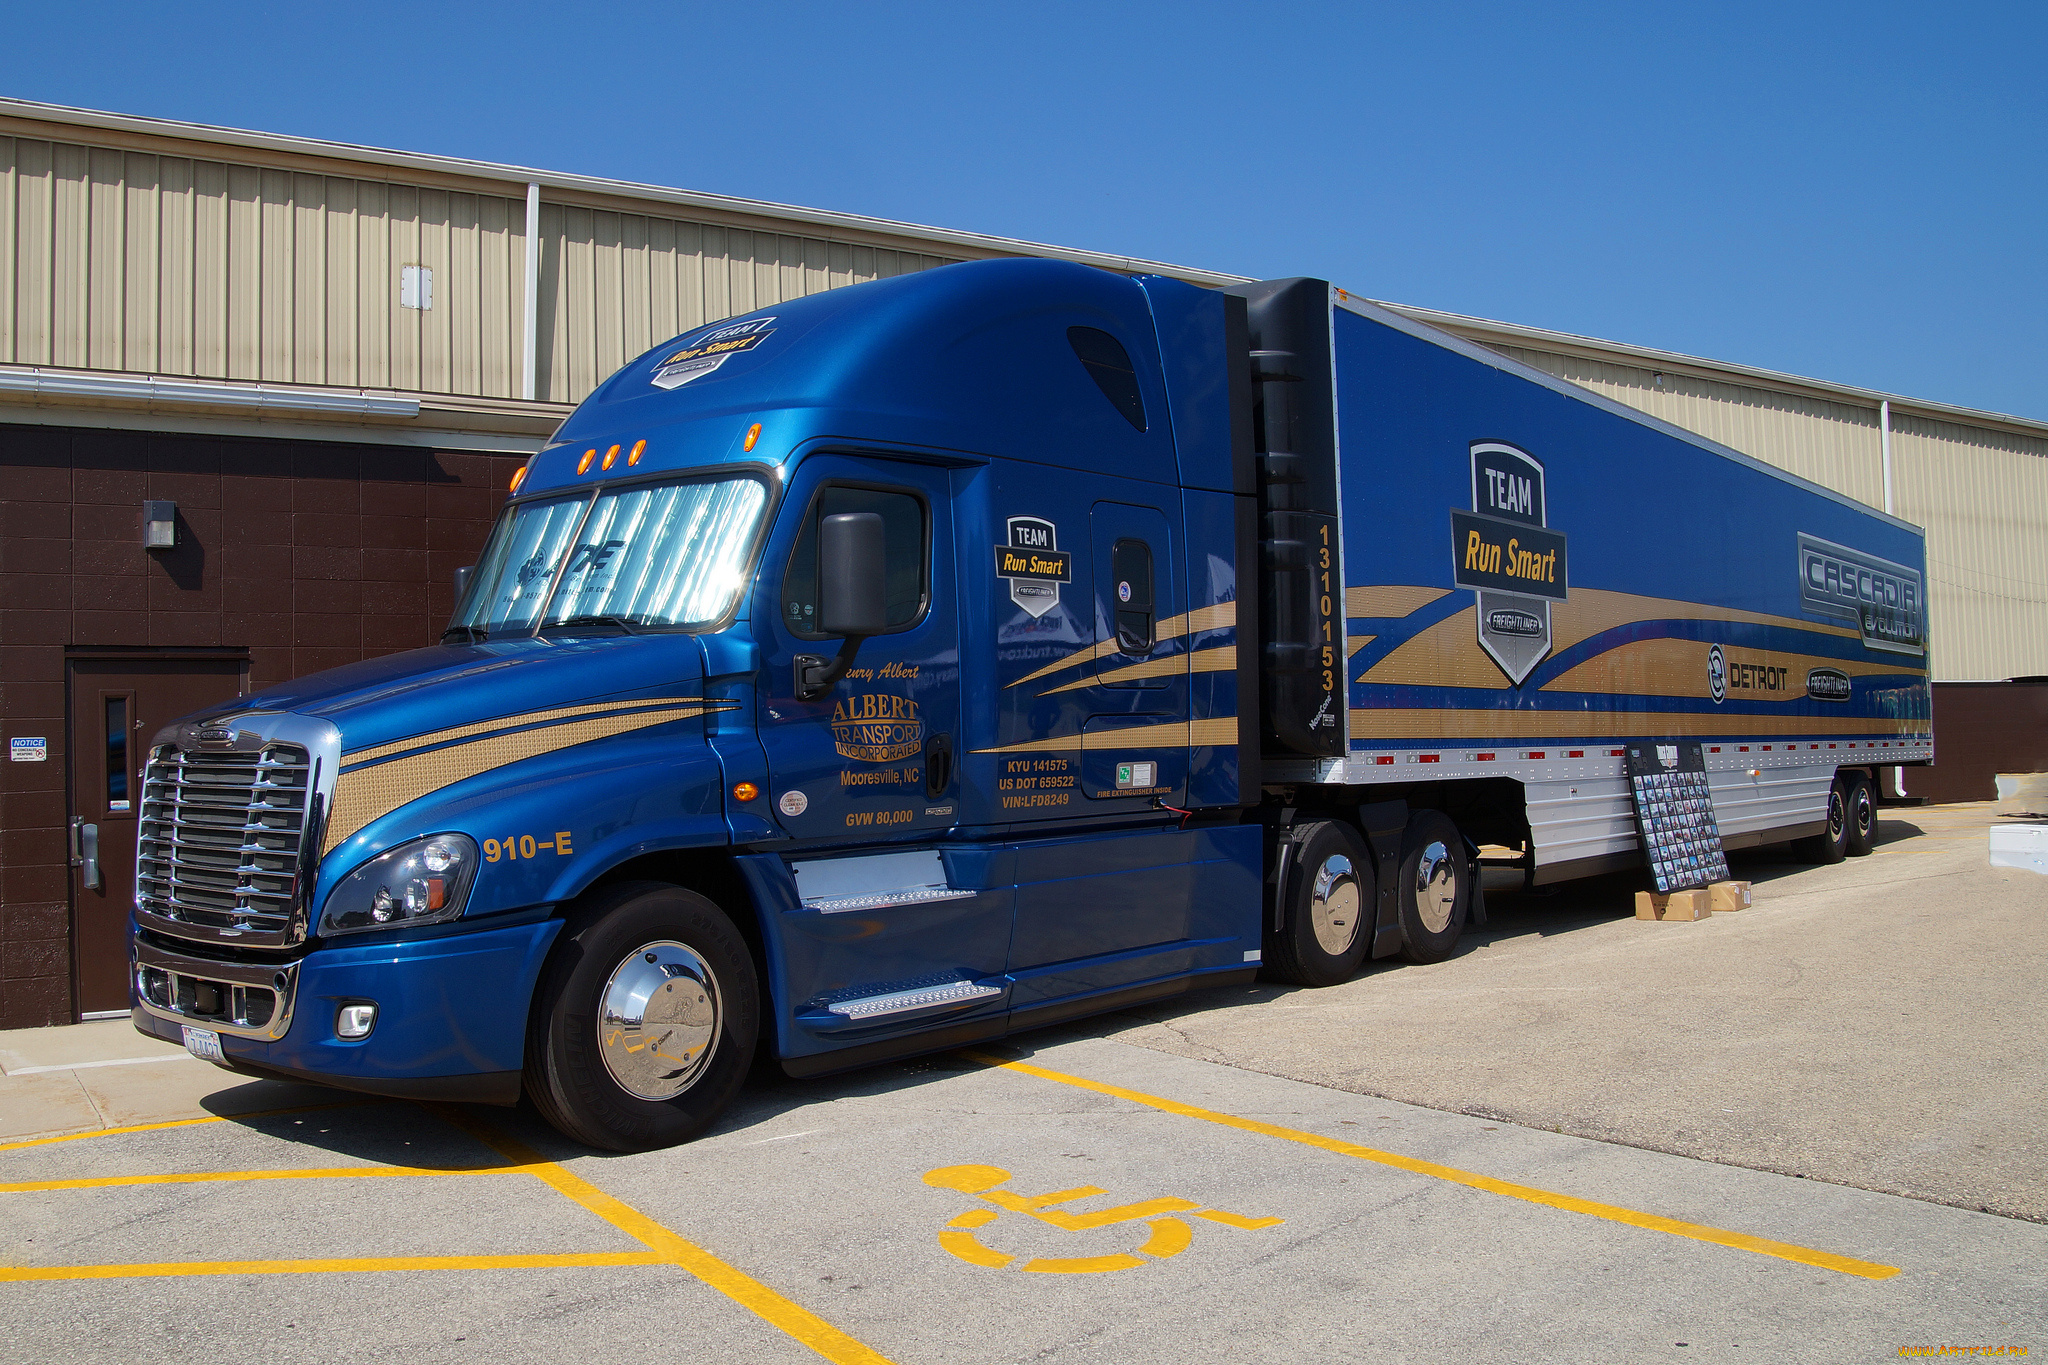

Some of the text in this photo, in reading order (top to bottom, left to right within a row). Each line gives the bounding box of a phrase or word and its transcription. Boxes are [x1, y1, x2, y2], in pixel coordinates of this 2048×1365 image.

[708, 323, 757, 341] TEAM
[664, 335, 757, 365] Run Smart
[1485, 467, 1532, 516] TEAM
[1016, 527, 1047, 547] TEAM
[1003, 553, 1063, 575] Run Smart
[1465, 530, 1556, 583] Run Smart
[1806, 555, 1917, 614] CASCADIA
[1492, 614, 1539, 632] FREIGHTLINER
[877, 661, 920, 679] Albert
[1729, 662, 1788, 691] DETROIT
[831, 694, 919, 722] ALBERT
[13, 739, 44, 747] NOTICE
[831, 725, 920, 744] TRANSPORT
[835, 741, 921, 760] INCORPORATED
[1007, 759, 1068, 773] KYU 141575
[840, 767, 919, 787] Mooresville, NC
[999, 775, 1074, 790] US DOT 659522
[1097, 786, 1172, 798] FIRE EXTINGUISHER INSIDE
[846, 812, 873, 827] GVW
[876, 809, 913, 826] 80,000
[483, 831, 573, 863] 910-E
